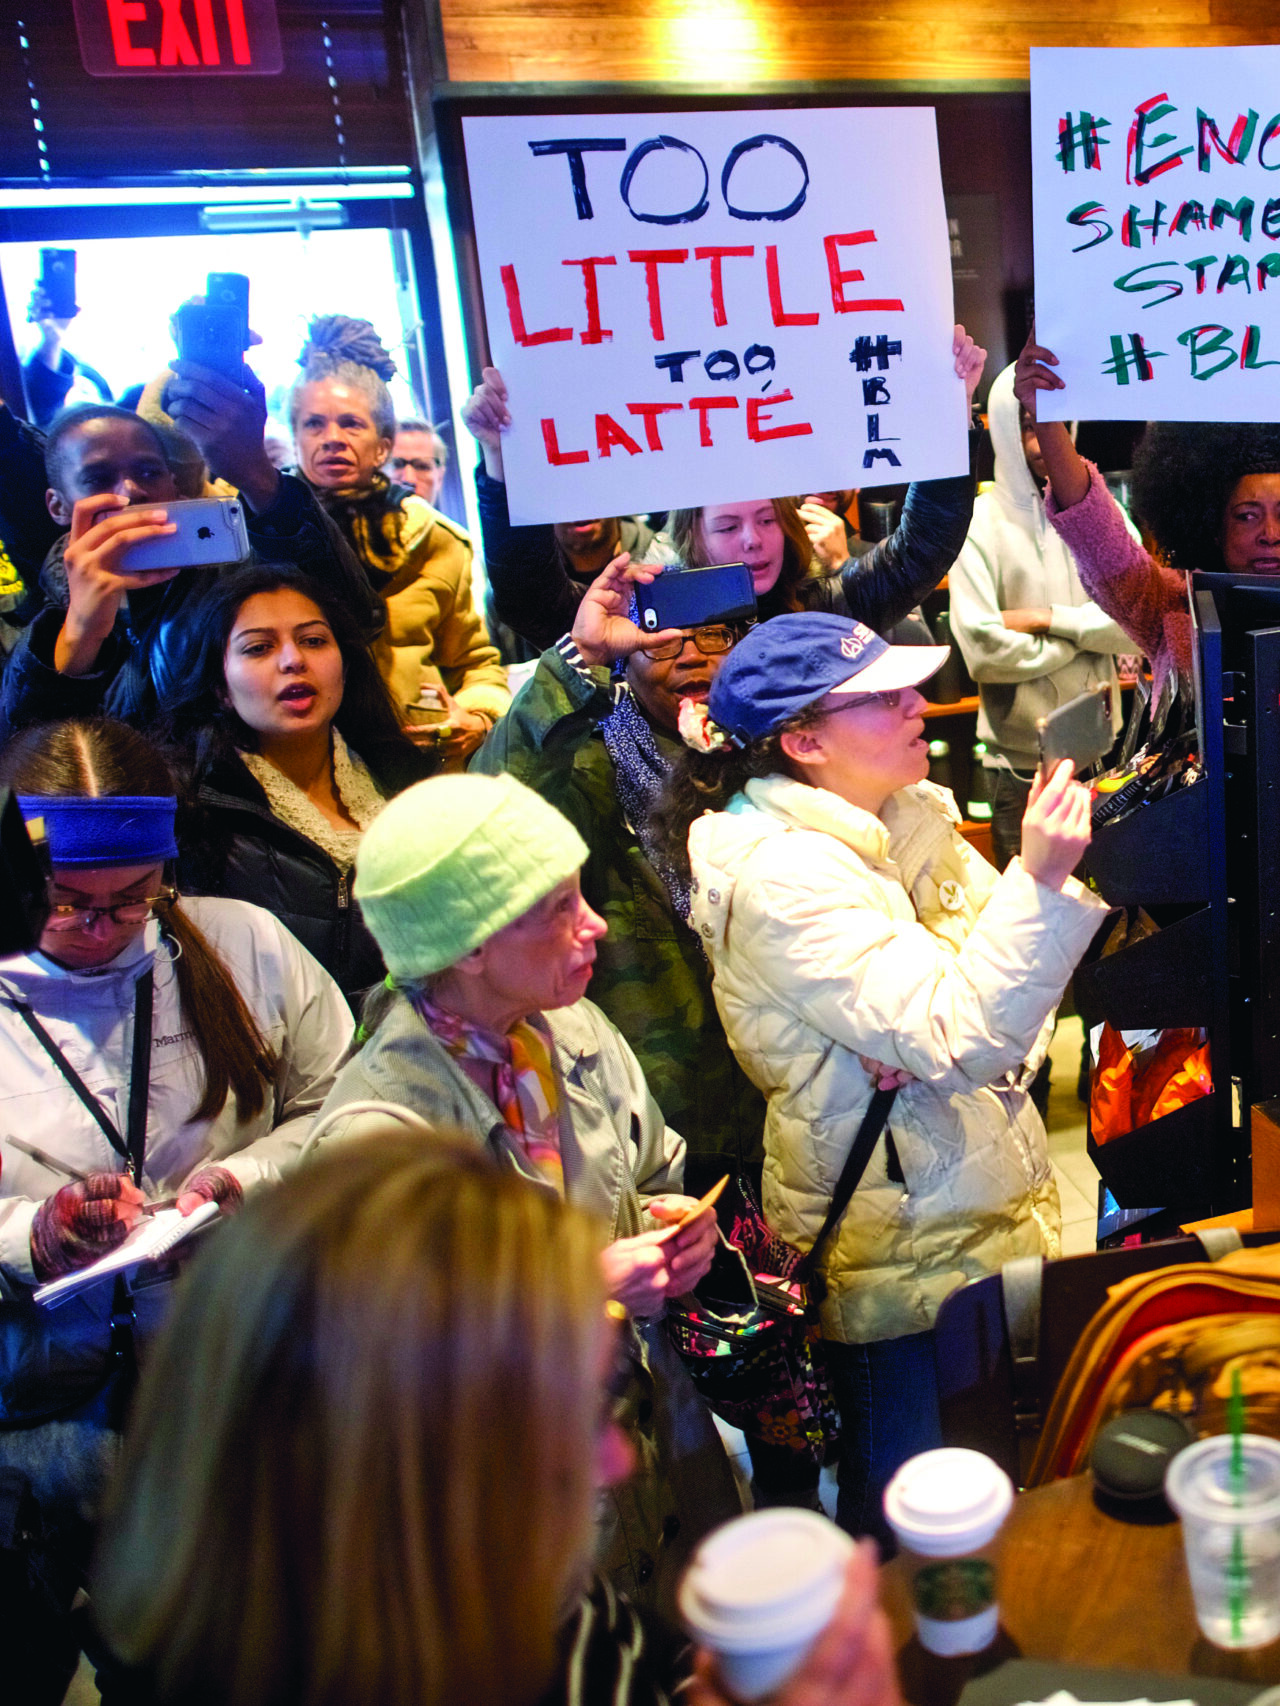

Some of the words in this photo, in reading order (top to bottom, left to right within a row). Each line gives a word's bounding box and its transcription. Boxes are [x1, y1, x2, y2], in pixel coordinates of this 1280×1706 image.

[528, 133, 809, 226] TOO
[500, 230, 905, 347] LITTLE
[654, 343, 776, 383] TOO
[540, 379, 813, 466] LATTÉ
[153, 1031, 193, 1047] Marm
